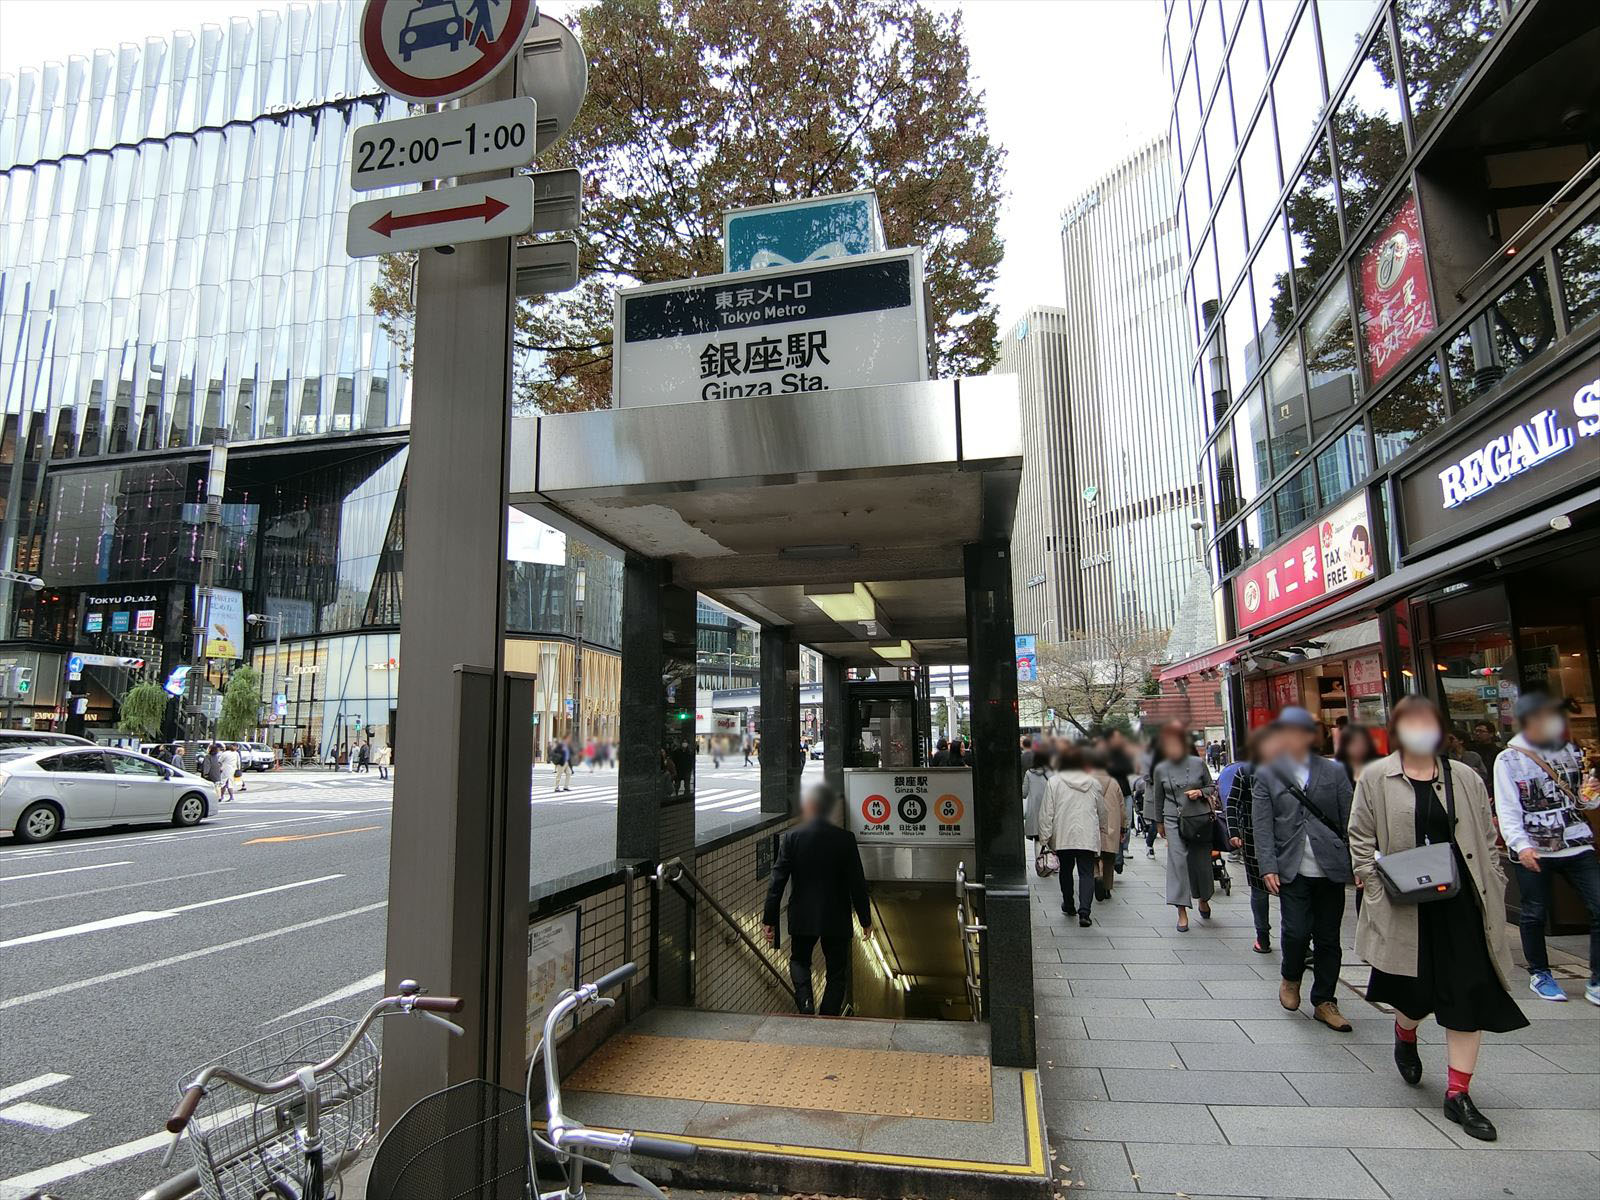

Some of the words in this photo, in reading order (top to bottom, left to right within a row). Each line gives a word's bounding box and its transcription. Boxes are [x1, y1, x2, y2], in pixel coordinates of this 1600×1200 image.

[714, 280, 812, 310] 東京メトロ
[720, 310, 761, 326] Tokyo
[764, 303, 807, 320] Metro
[699, 329, 830, 380] 銀座駅
[701, 381, 773, 401] Ginza
[780, 372, 829, 395] Sta.
[1438, 409, 1576, 509] REGAL
[1324, 546, 1342, 568] TAX
[1266, 545, 1319, 602] 不二家
[1326, 565, 1348, 589] FREE
[89, 597, 122, 605] TOKYU
[124, 595, 157, 603] PLAZA
[894, 776, 928, 787] 銀座駅
[871, 808, 882, 816] 16
[906, 808, 918, 816] 08
[943, 808, 955, 816] 09
